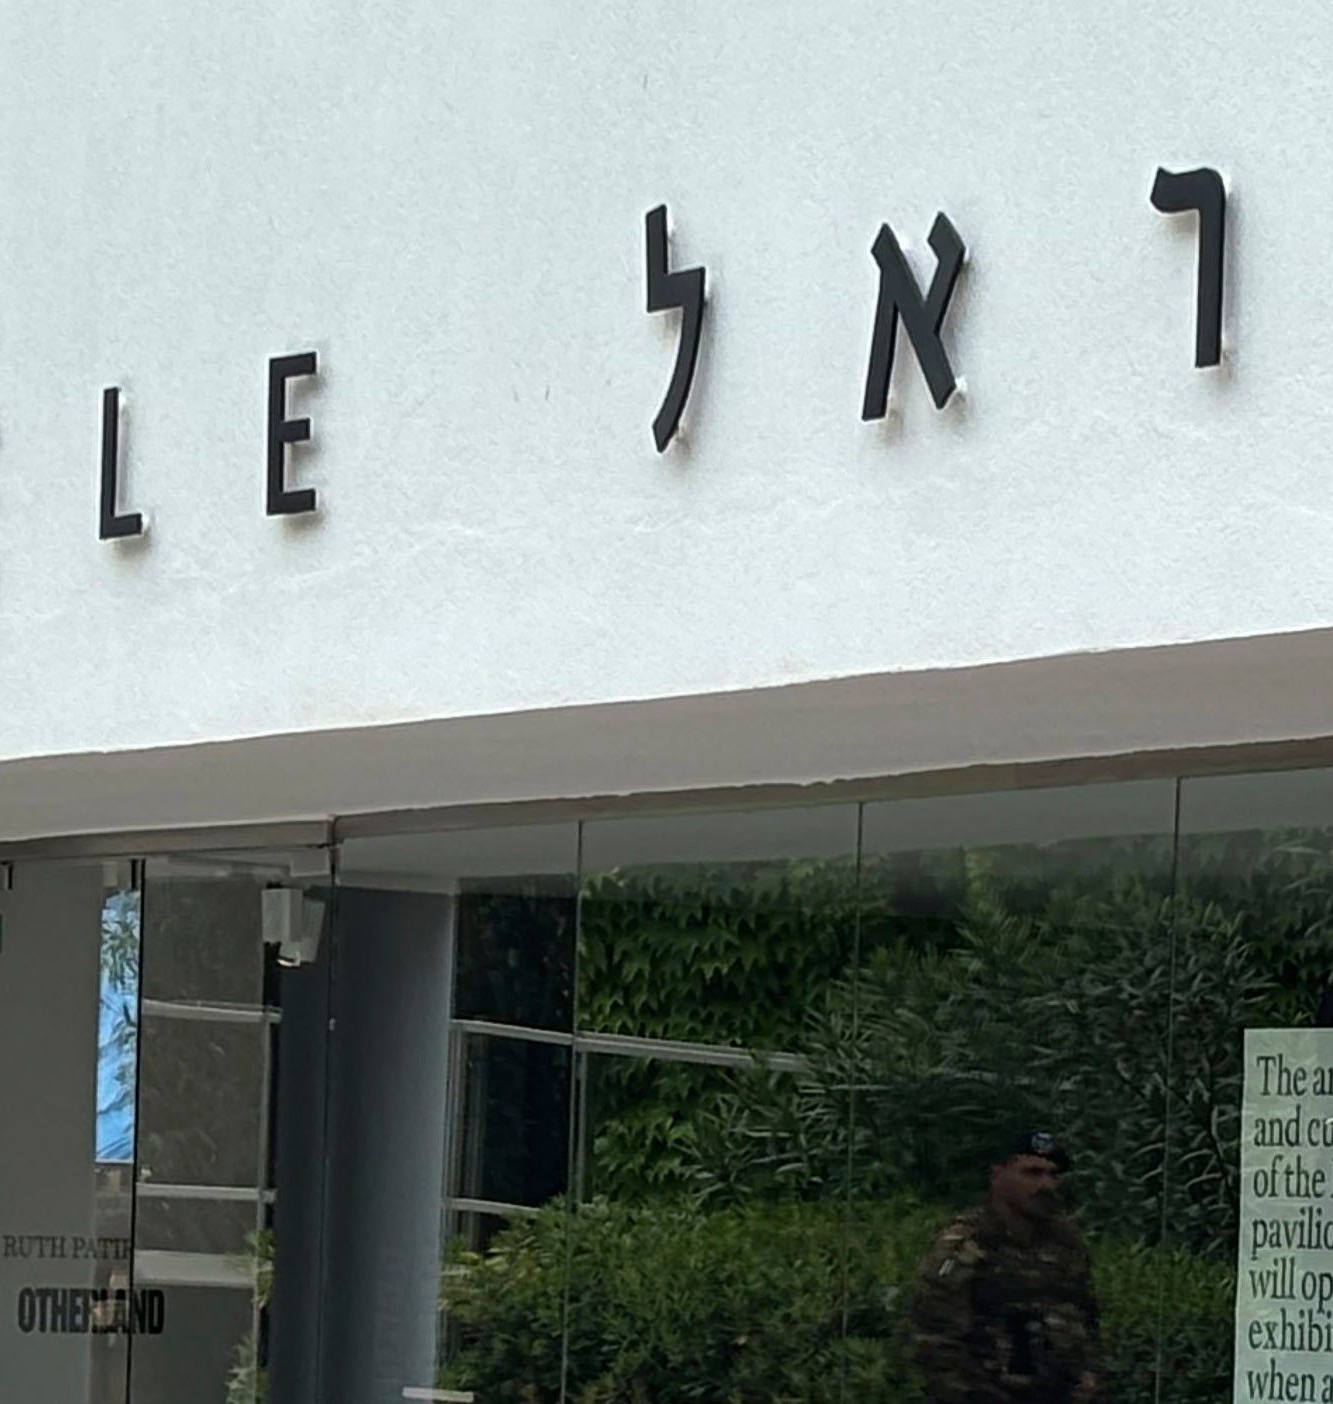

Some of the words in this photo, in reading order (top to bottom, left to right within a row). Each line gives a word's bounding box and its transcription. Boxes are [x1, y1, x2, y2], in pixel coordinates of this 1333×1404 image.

[1256, 1052, 1307, 1097] The
[1253, 1103, 1304, 1147] and
[1253, 1154, 1284, 1198] of
[1285, 1154, 1325, 1199] the
[1, 1234, 67, 1260] RUTH
[1249, 1257, 1296, 1300] will
[1246, 1358, 1316, 1403] when
